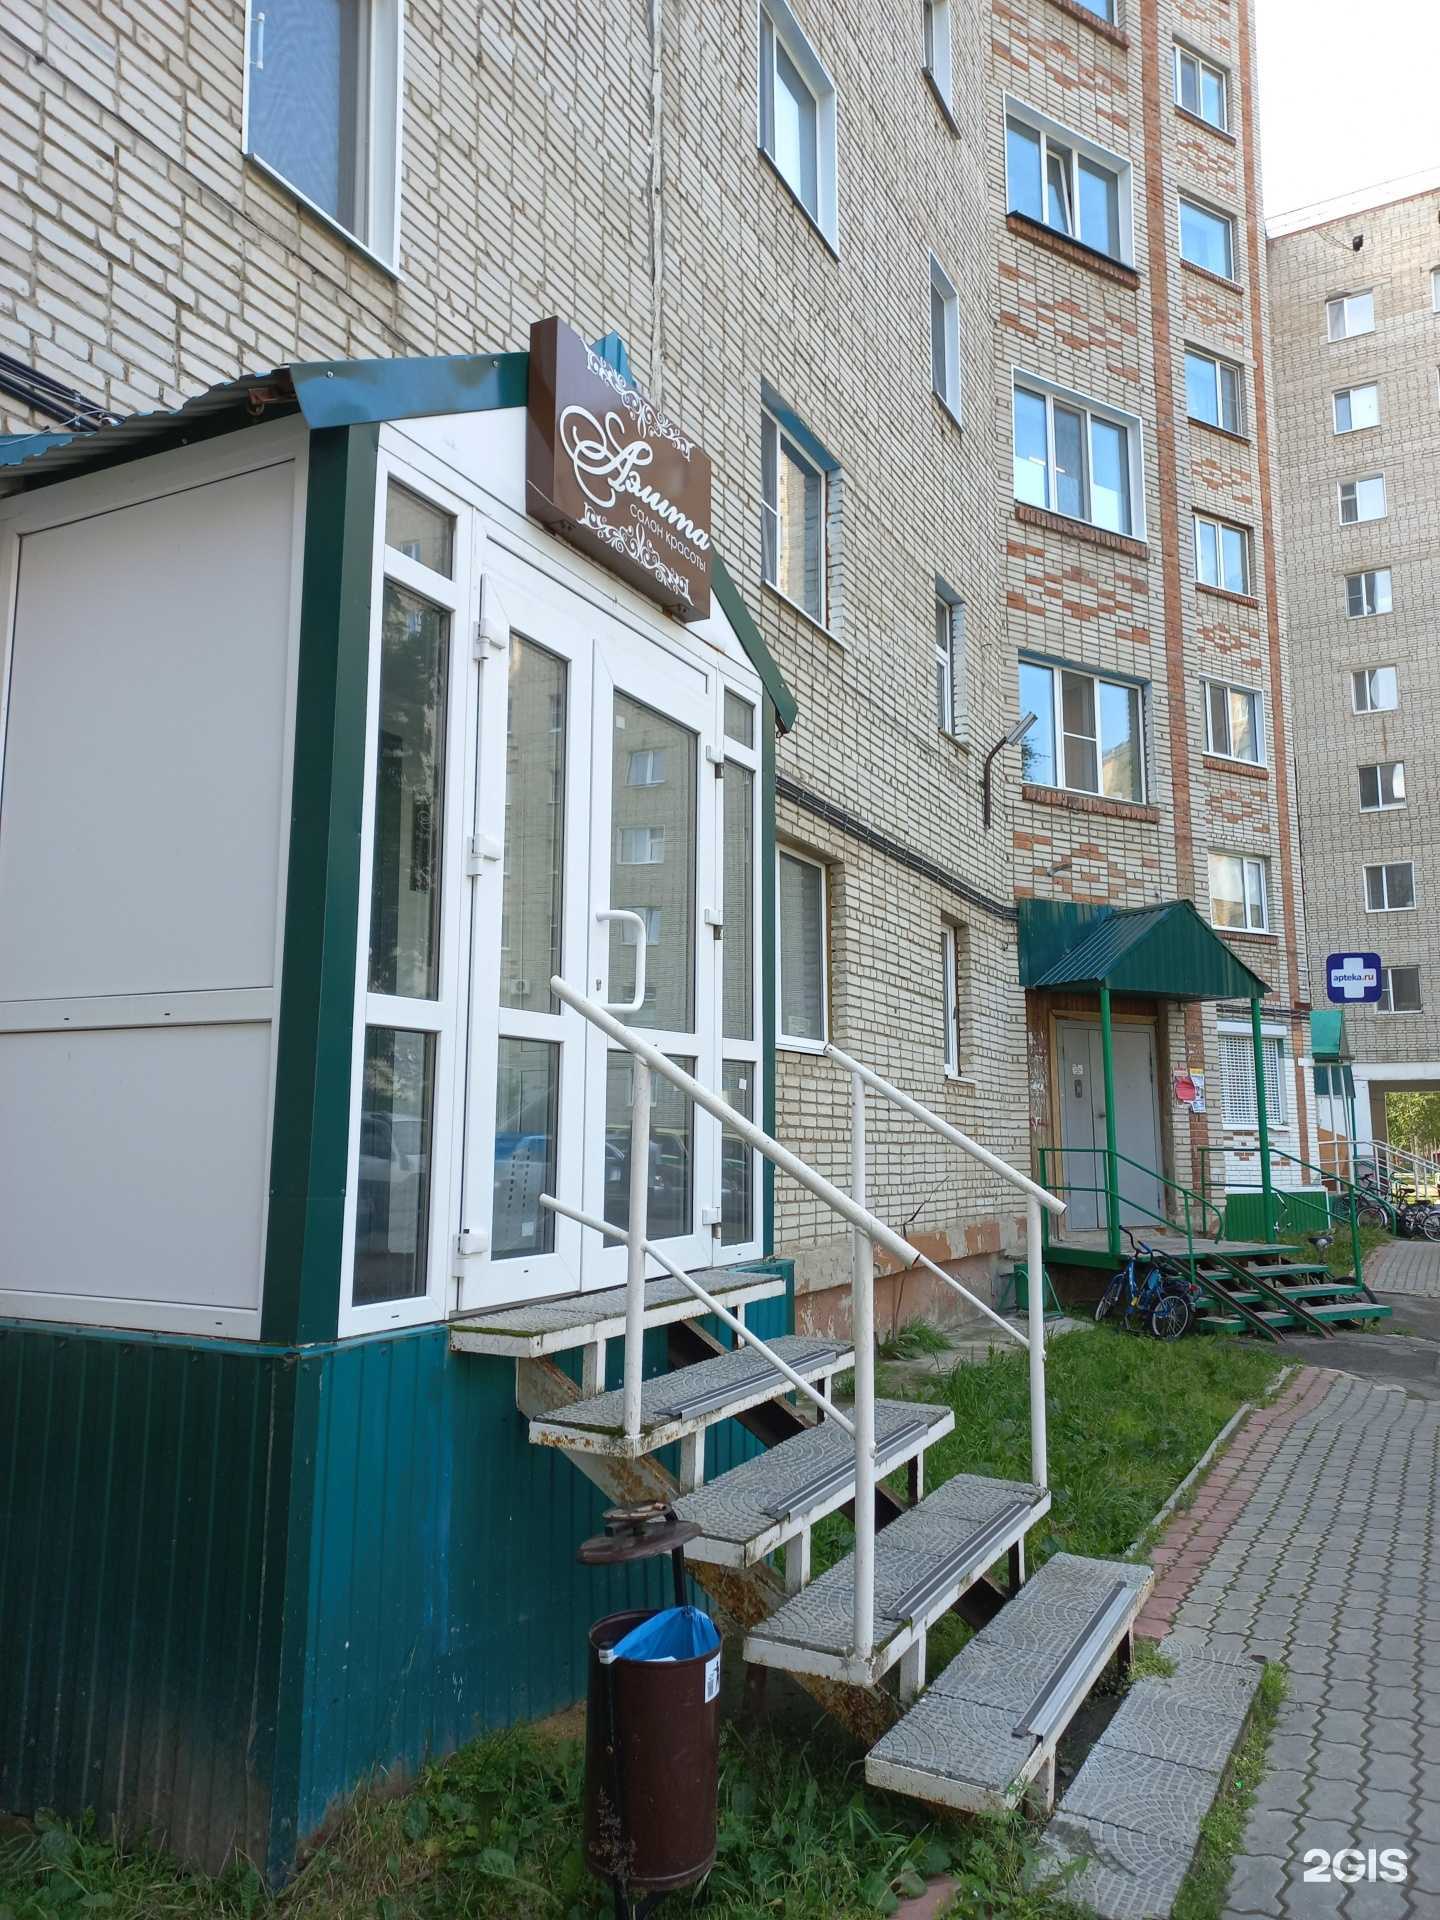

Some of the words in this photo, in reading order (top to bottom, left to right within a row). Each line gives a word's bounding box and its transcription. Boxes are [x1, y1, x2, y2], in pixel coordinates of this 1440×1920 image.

[560, 405, 711, 550] Аэлита
[629, 503, 664, 539] салон
[665, 531, 706, 573] красоты
[1333, 973, 1374, 982] apteka.ru
